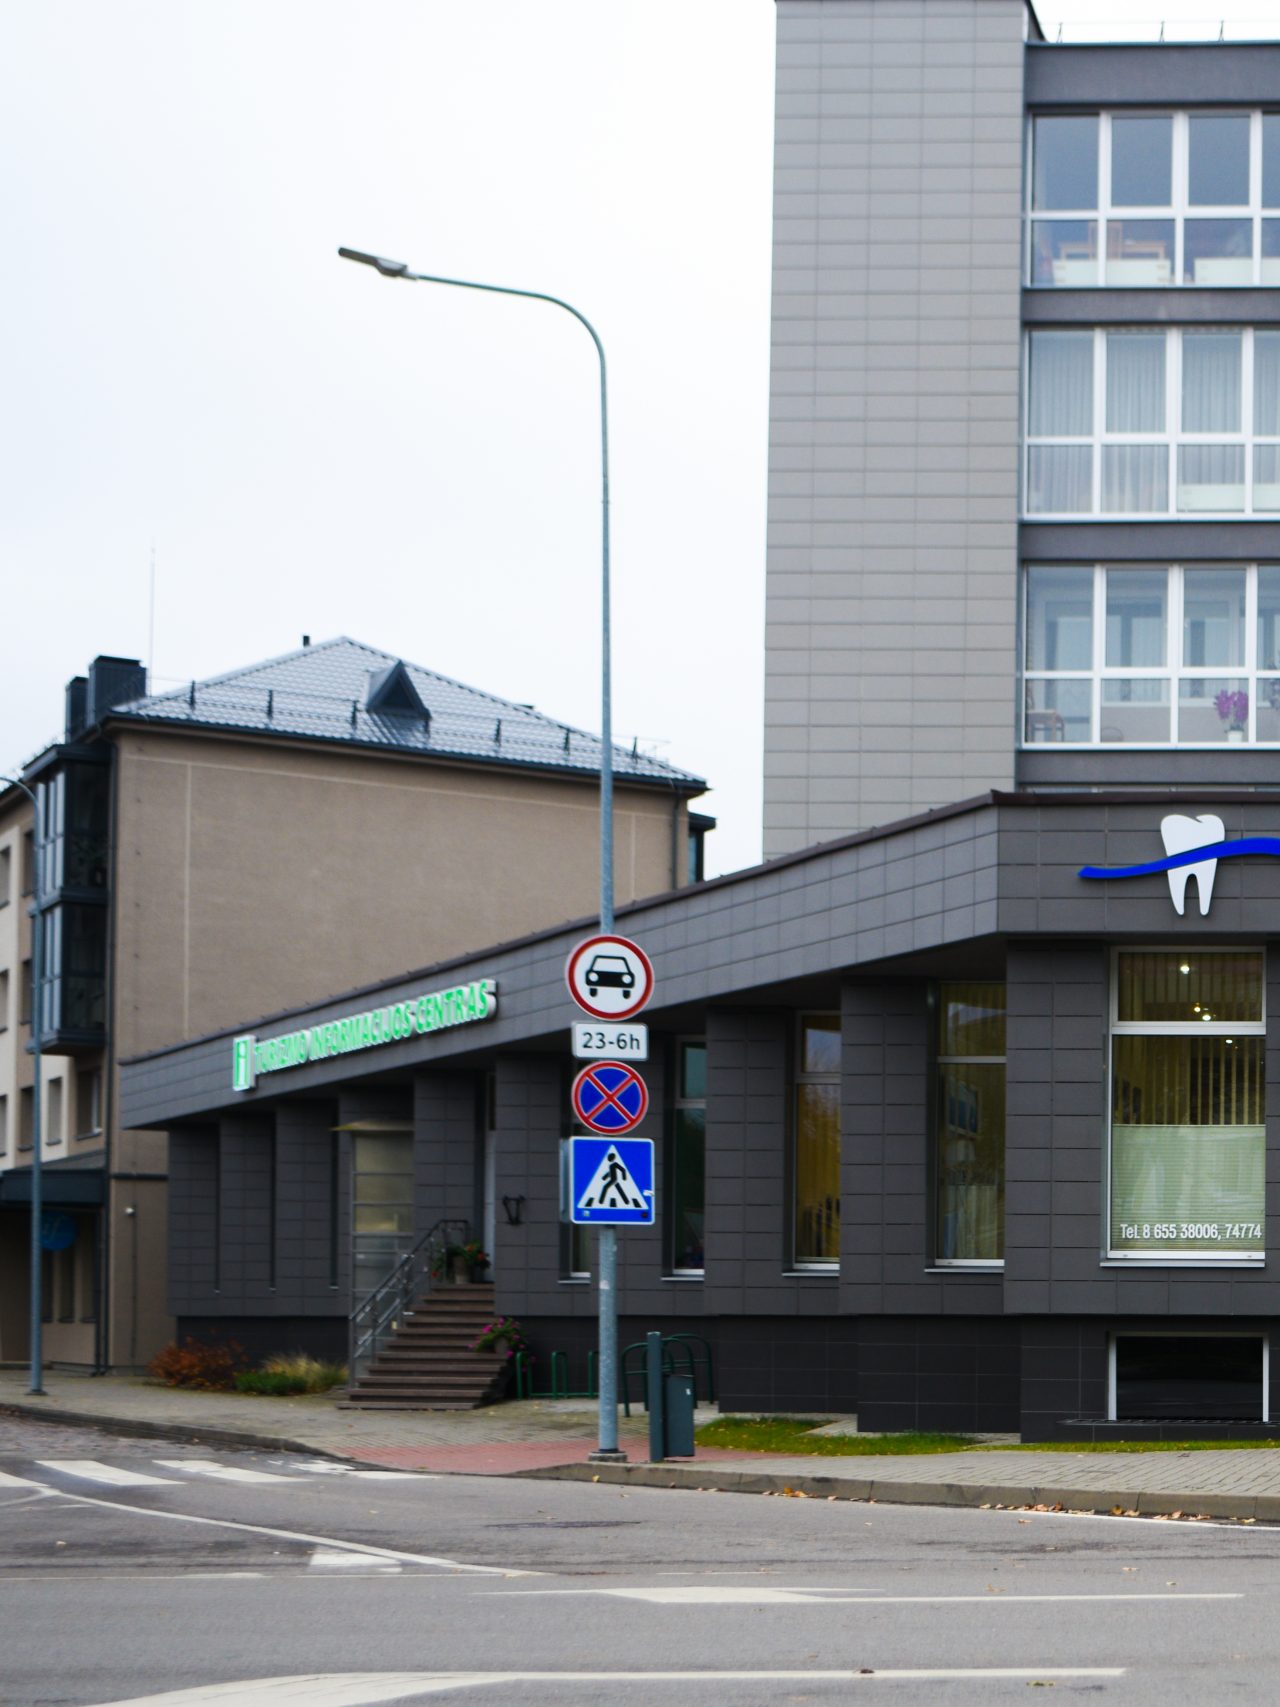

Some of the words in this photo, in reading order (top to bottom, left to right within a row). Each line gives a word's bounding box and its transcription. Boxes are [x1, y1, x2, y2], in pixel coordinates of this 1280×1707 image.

[255, 1030, 310, 1074] TURIZMO
[309, 1000, 416, 1061] INFORMACIJOS
[415, 979, 497, 1034] CENTRAS
[582, 1031, 641, 1051] 23-6h
[1143, 1223, 1151, 1239] 8
[1154, 1223, 1177, 1239] 655
[1180, 1223, 1222, 1241] 38006,
[1225, 1223, 1263, 1239] 74774
